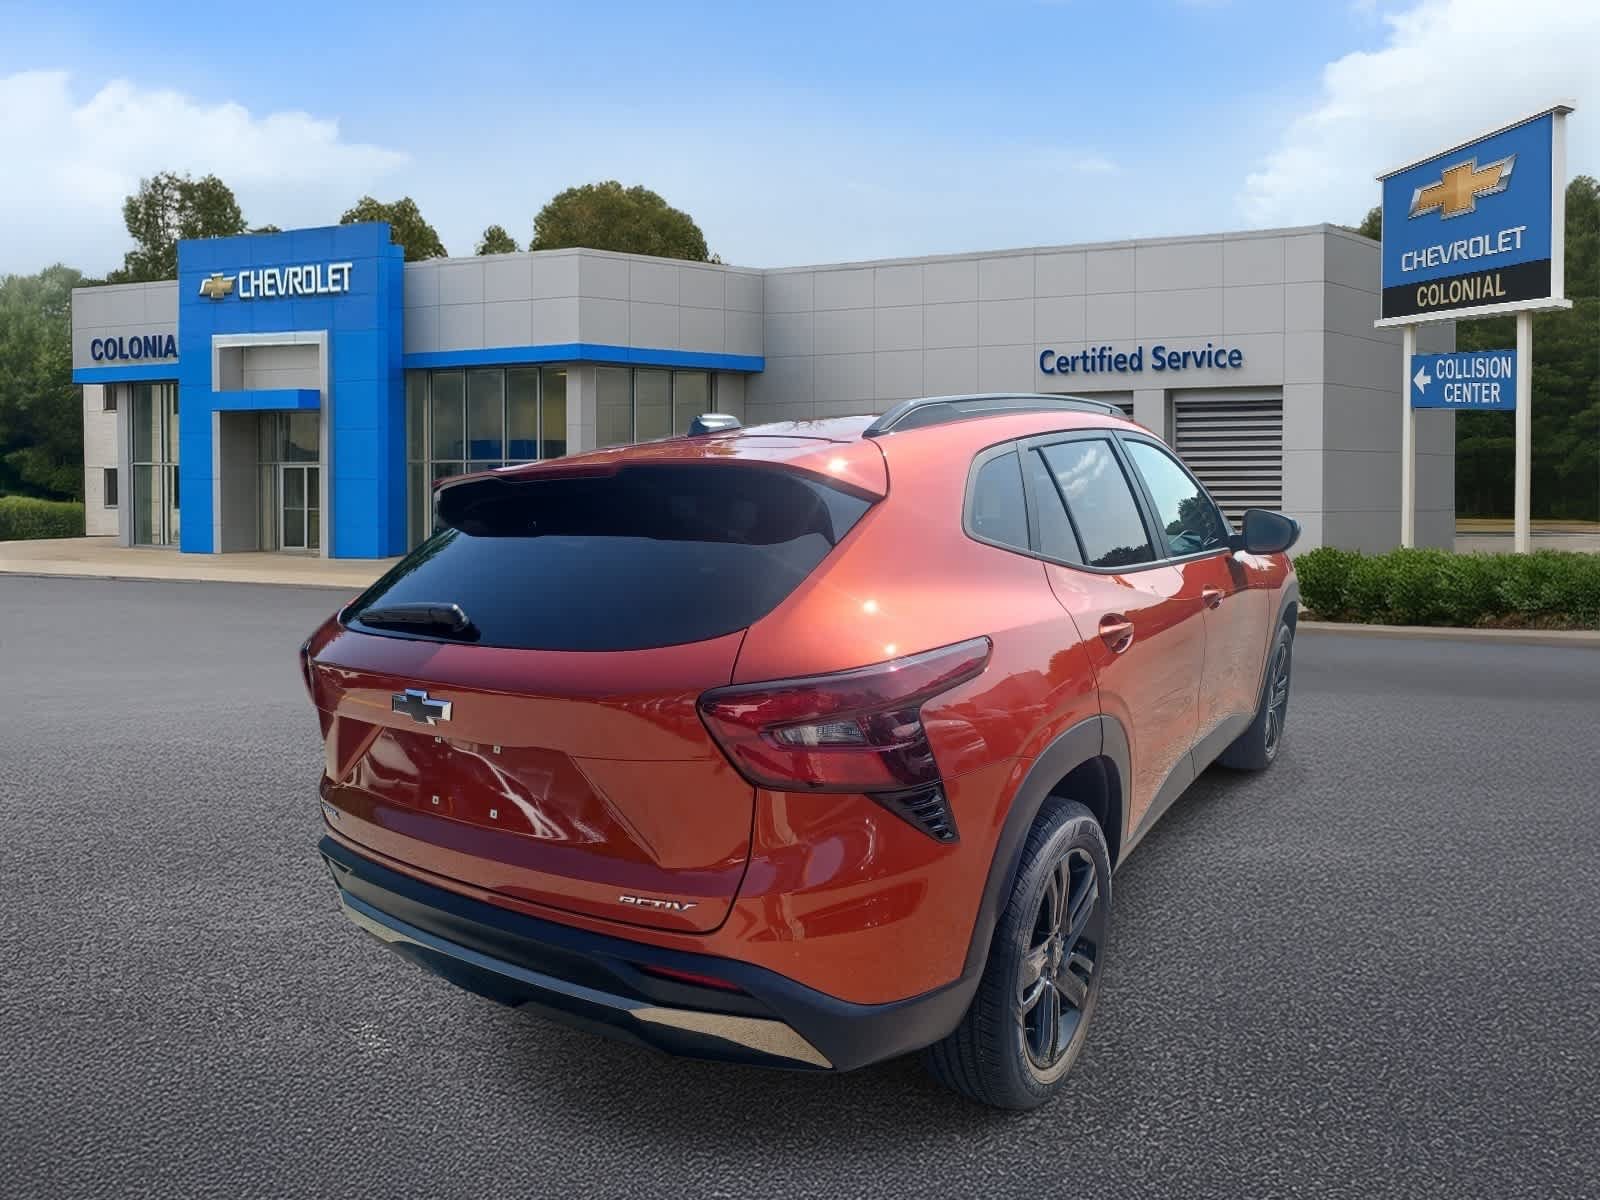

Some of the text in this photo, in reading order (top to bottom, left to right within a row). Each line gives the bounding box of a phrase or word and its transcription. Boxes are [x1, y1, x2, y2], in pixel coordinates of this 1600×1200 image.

[1402, 225, 1527, 272] CHEVROLET
[238, 262, 353, 298] CHEVROLET
[1417, 274, 1506, 306] COLONIAL
[1039, 343, 1243, 375] Certified Service
[1436, 356, 1512, 379] COLLISION
[1444, 382, 1501, 403] CENTER
[618, 895, 698, 912] ACTIV
